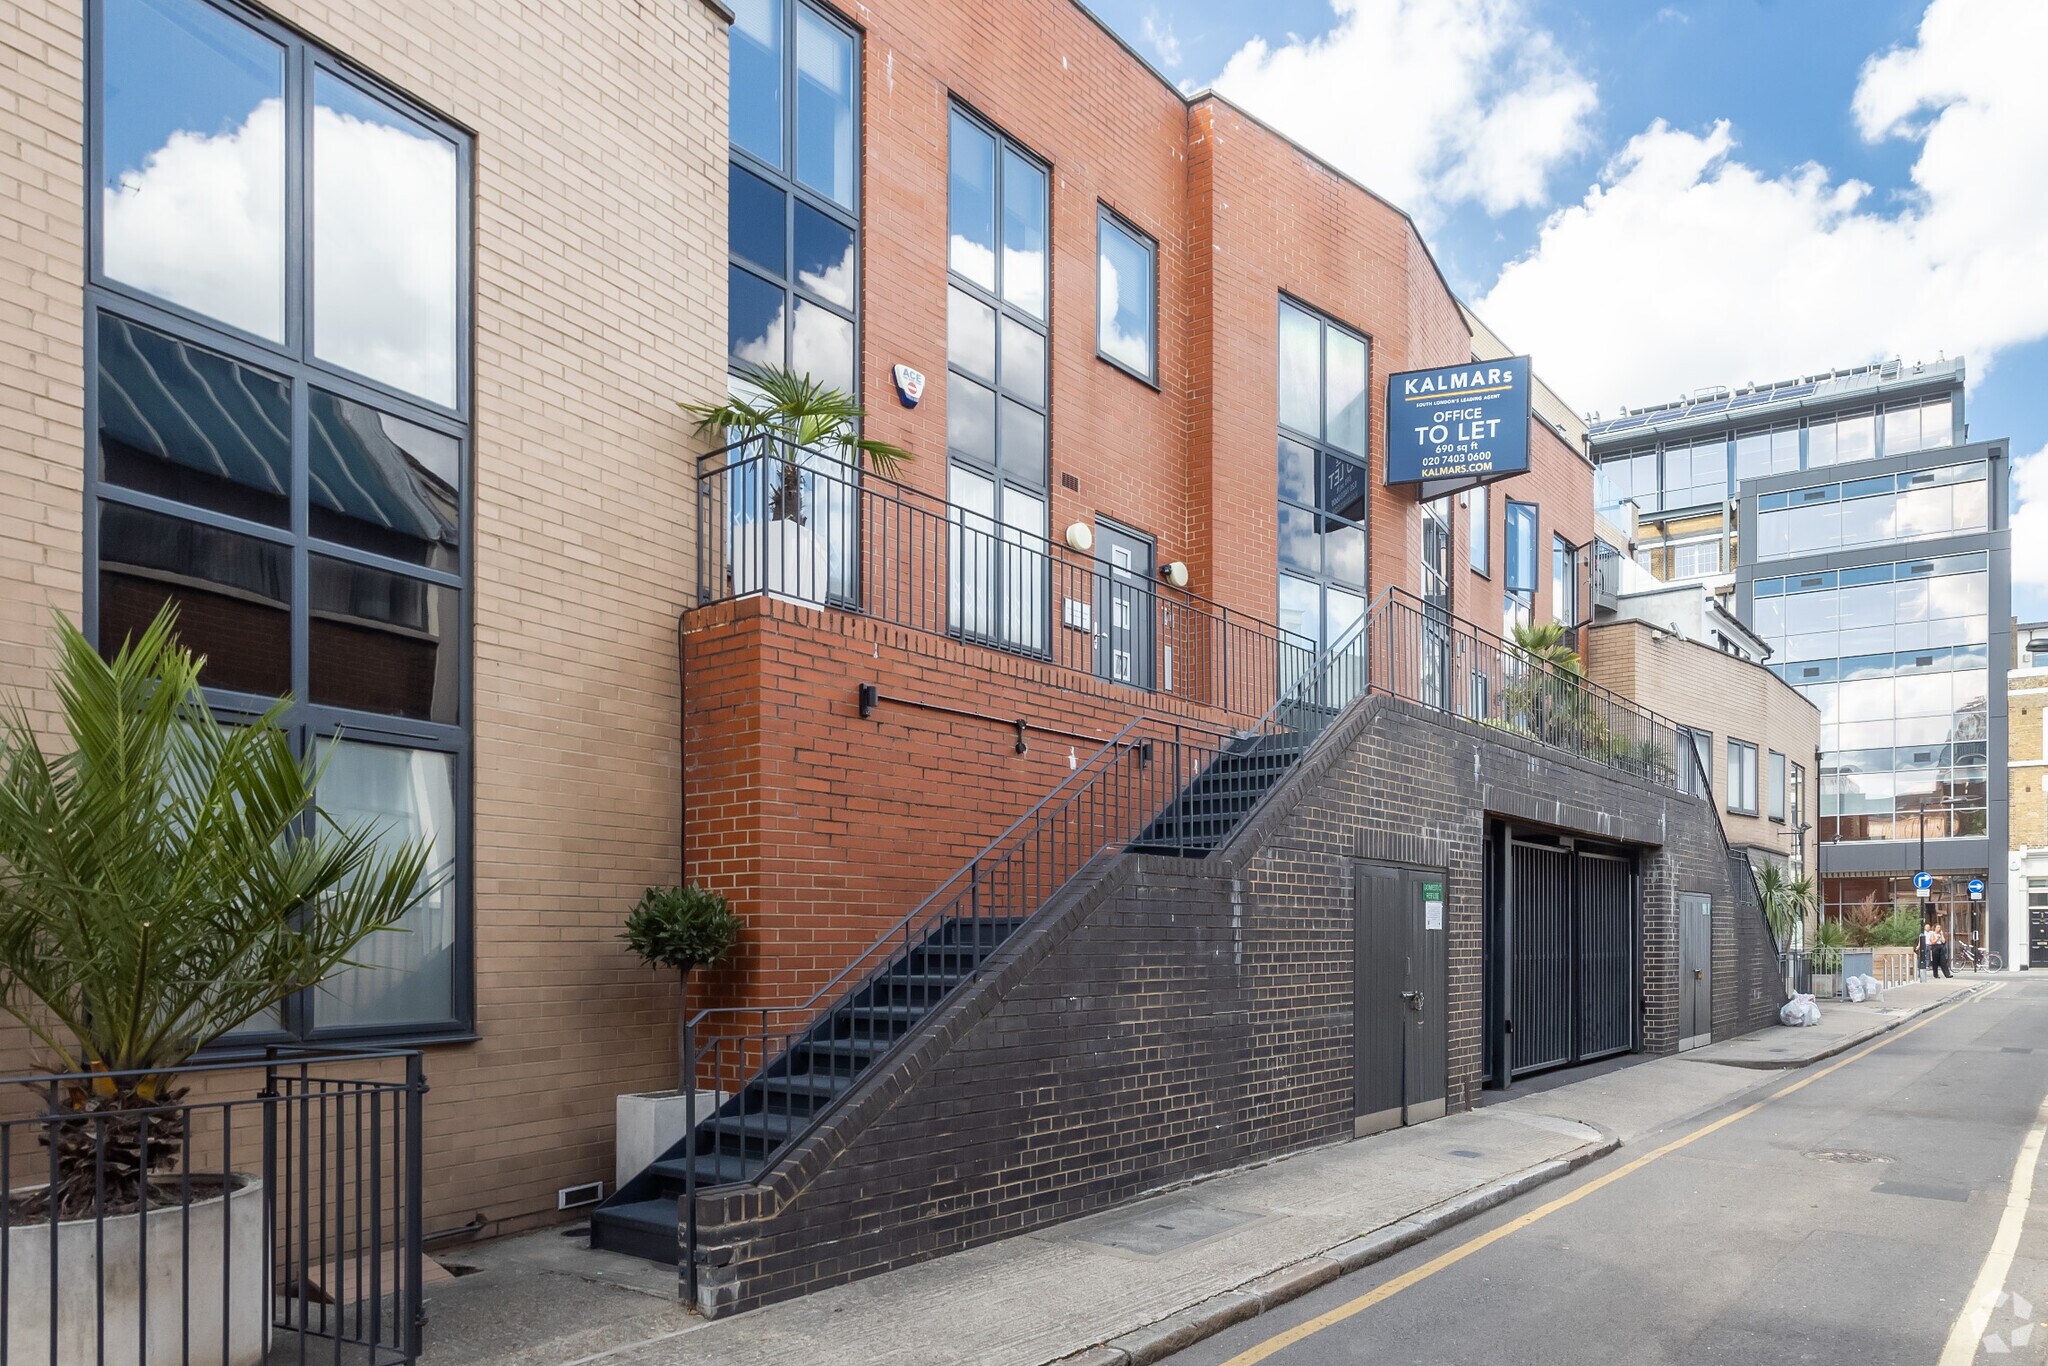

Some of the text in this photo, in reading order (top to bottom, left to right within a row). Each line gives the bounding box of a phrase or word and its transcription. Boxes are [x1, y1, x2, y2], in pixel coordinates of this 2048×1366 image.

[903, 368, 922, 383] ACE
[1434, 398, 1459, 406] LONDON'S
[1460, 395, 1482, 403] LEADING
[1433, 407, 1482, 423] OFFICE
[1414, 419, 1501, 446] TO LET
[1435, 441, 1478, 454] 690 sq ft
[1422, 451, 1491, 466] 020 7403 0600
[1421, 462, 1492, 478] KALMARS.COM
